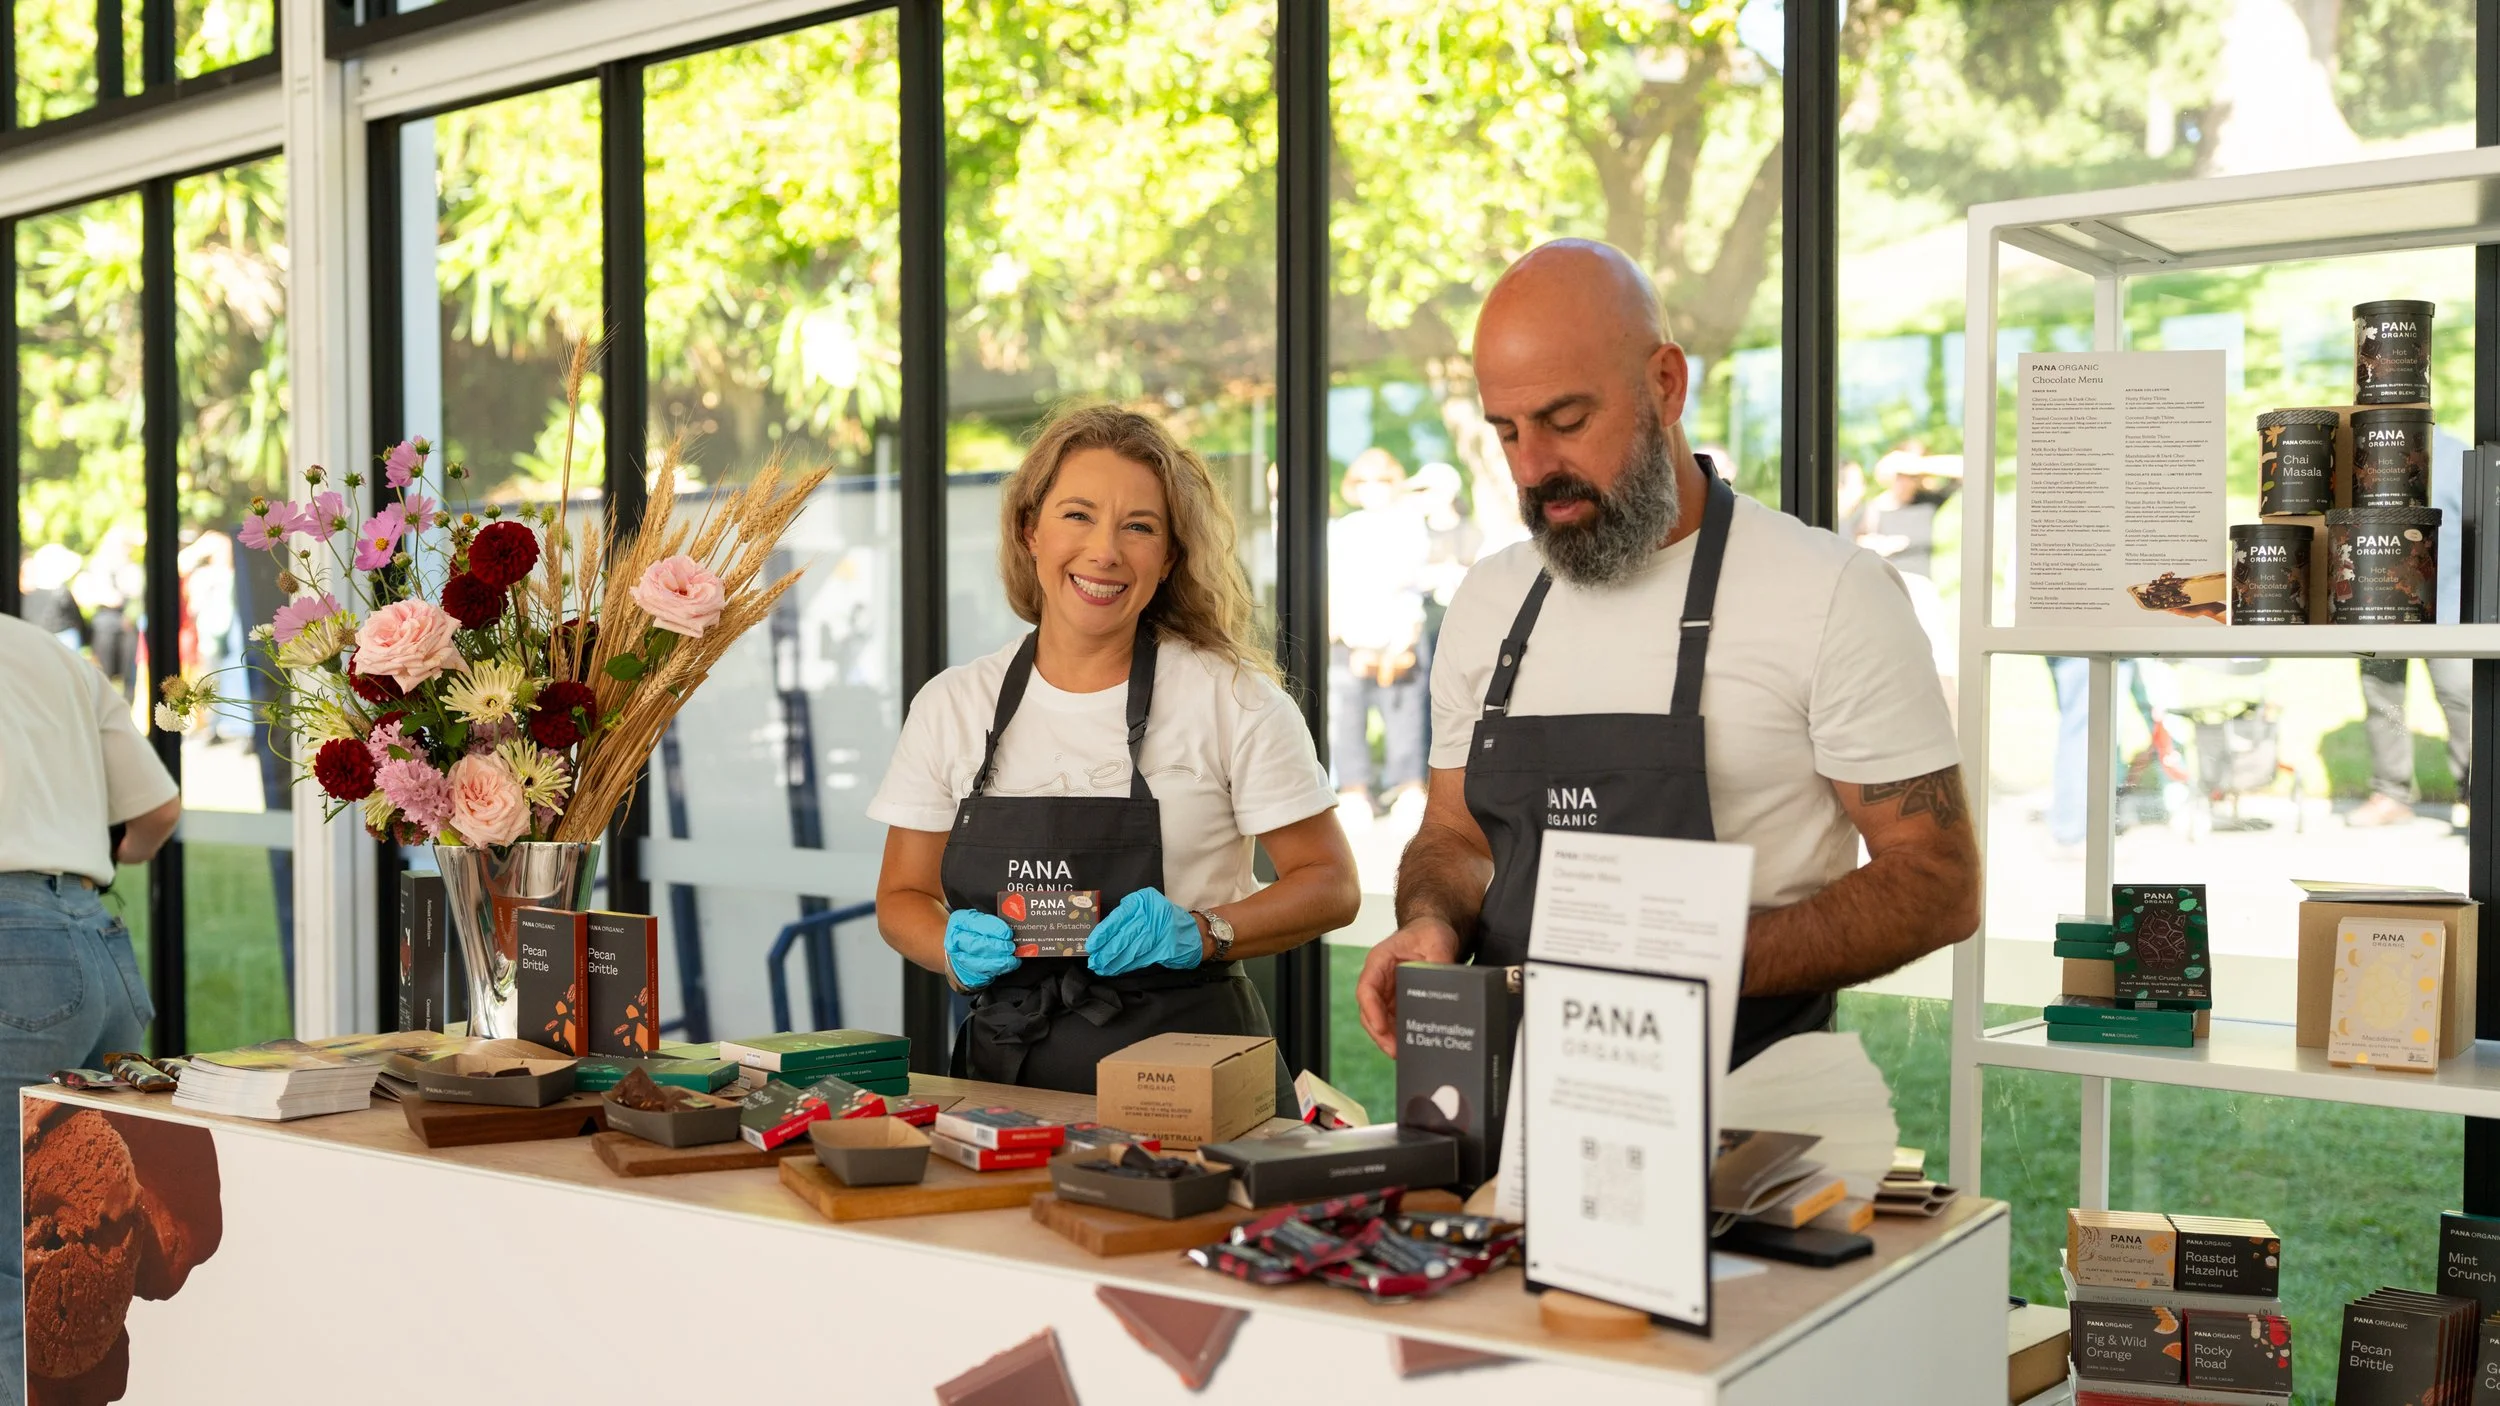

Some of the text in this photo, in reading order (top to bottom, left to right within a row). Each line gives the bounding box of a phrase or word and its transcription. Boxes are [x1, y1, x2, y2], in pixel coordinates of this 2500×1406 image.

[2381, 322, 2417, 331] PANA
[2032, 376, 2076, 384] Chocolate
[2369, 430, 2405, 440] PANA
[2283, 455, 2309, 464] Chai
[2283, 467, 2322, 477] Masala
[2357, 535, 2401, 547] PANA
[2250, 546, 2286, 556] PANA
[1547, 787, 1597, 810] ANA
[1008, 859, 1072, 879] PANA
[1007, 882, 1073, 892] ORGANIC
[1030, 899, 1066, 908] PANA
[535, 922, 555, 930] ORGANIC
[601, 926, 624, 934] ORGANIC
[1057, 922, 1091, 930] Pistachio
[2372, 933, 2405, 942] PANA
[522, 944, 547, 957] Pecan
[588, 947, 616, 960] Pecan
[522, 958, 549, 972] Brittle
[588, 962, 618, 975] Brittle
[1563, 998, 1662, 1043] PANA
[1406, 1019, 1476, 1037] Marshmallow
[1416, 1033, 1442, 1047] Dark
[1443, 1036, 1473, 1051] Choc
[1137, 1072, 1175, 1083] PANA
[1151, 1133, 1203, 1142] AUSTRALIA
[2111, 1234, 2142, 1244] PANA
[2450, 1229, 2471, 1237] PANA
[2123, 1256, 2154, 1264] Caramel
[2186, 1251, 2236, 1264] Roasted
[2448, 1252, 2478, 1266] Mint
[2185, 1264, 2239, 1278] Hazelnut
[2447, 1266, 2496, 1283] Crunch
[2353, 1316, 2408, 1330] PANA ORGANIC
[2086, 1333, 2147, 1348] Fig & Wild
[2086, 1347, 2132, 1362] Orange
[2194, 1343, 2232, 1359] Rocky
[2351, 1340, 2392, 1357] Pecan
[2195, 1357, 2227, 1369] Road
[2349, 1355, 2394, 1372] Brittle
